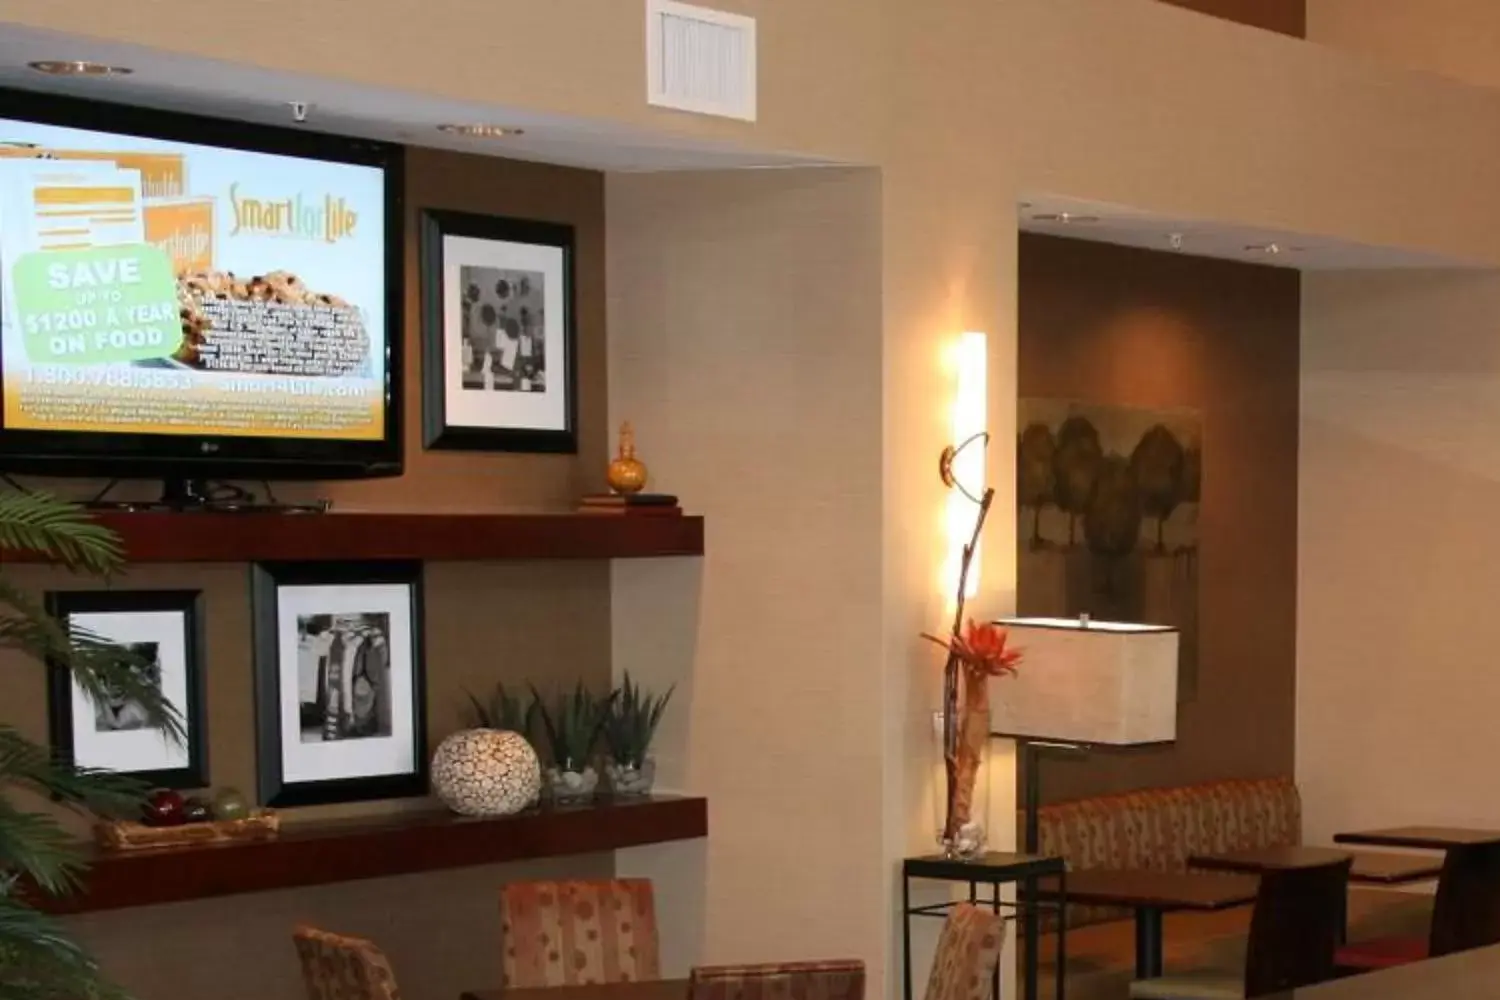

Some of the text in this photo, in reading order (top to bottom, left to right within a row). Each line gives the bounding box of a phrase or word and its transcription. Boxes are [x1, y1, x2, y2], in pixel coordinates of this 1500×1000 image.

[48, 258, 141, 290] SAVE
[26, 301, 175, 334] $1200 A YEAR
[51, 327, 163, 355] ON FOOD
